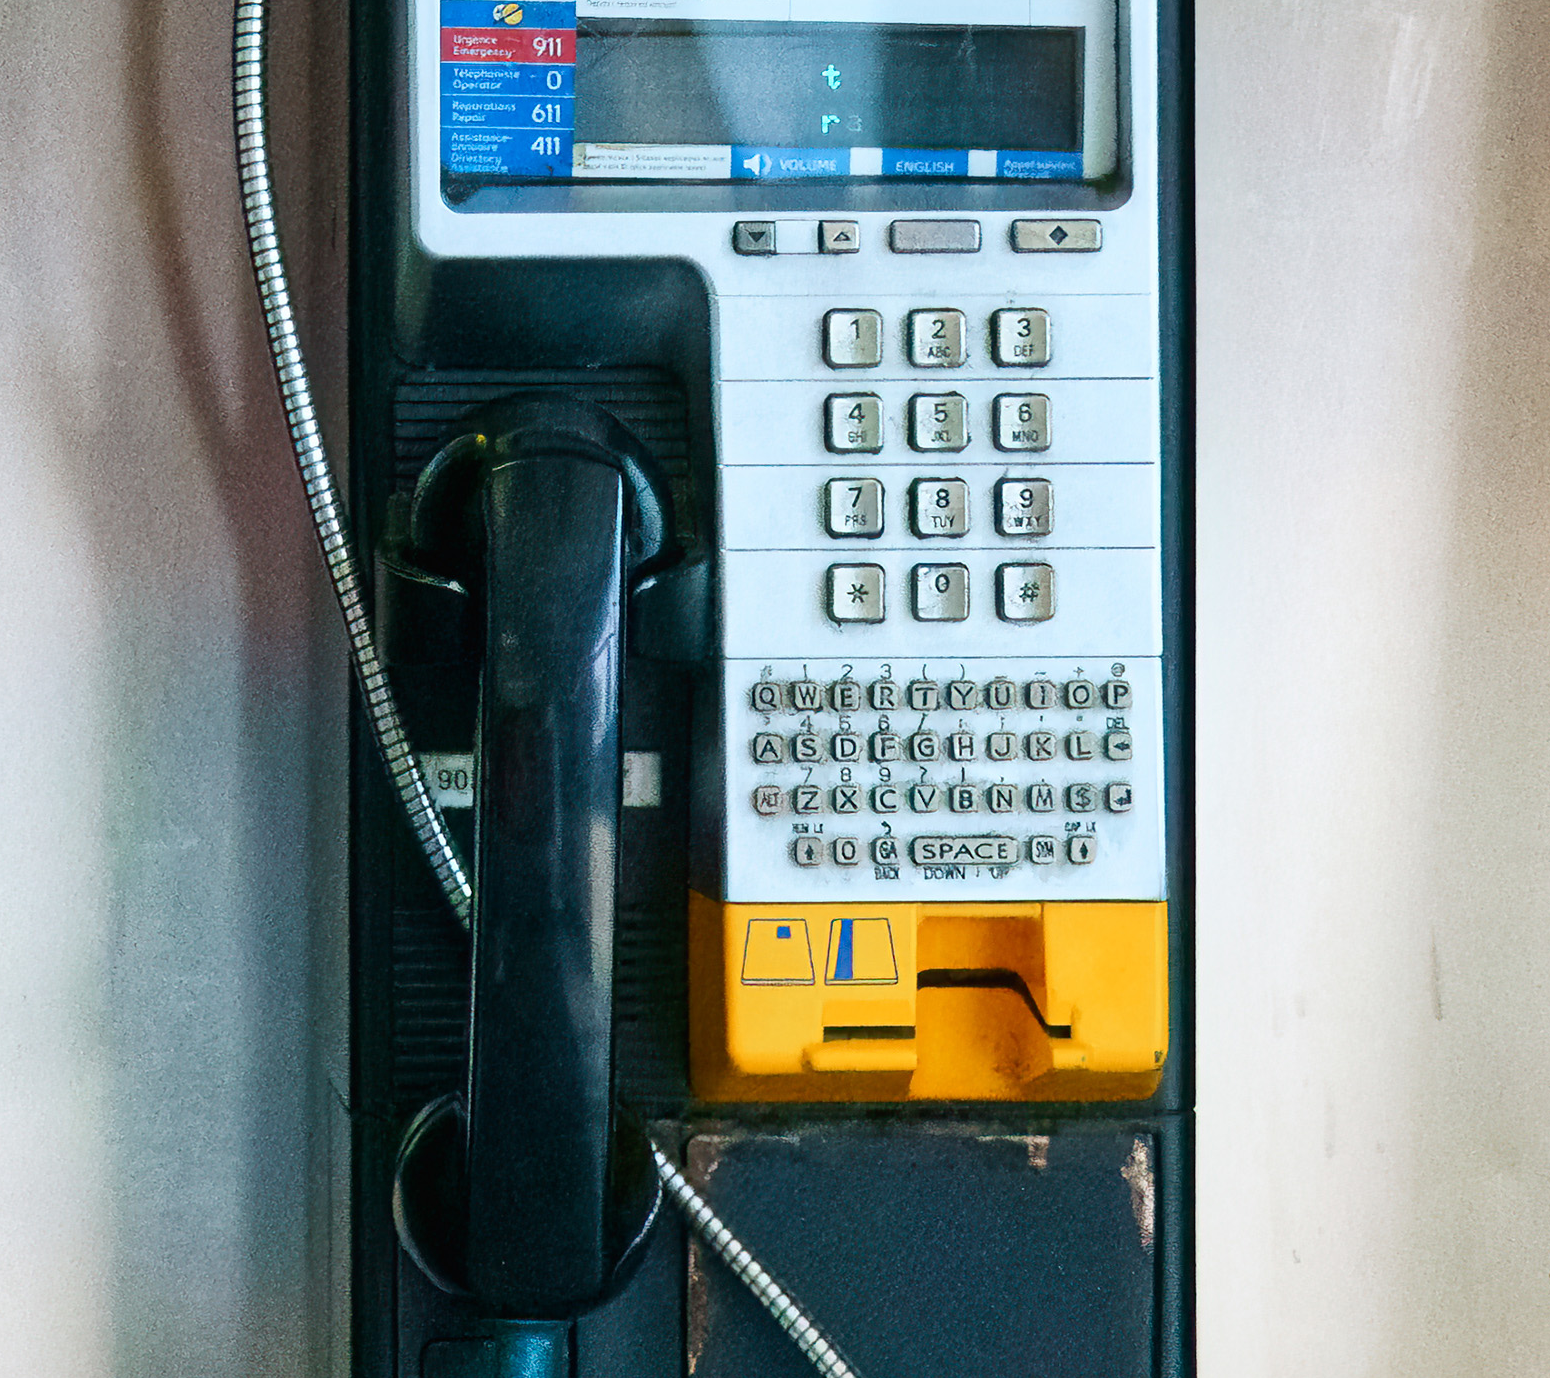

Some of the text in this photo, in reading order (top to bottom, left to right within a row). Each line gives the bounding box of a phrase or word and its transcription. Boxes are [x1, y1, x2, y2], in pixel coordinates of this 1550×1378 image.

[453, 35, 562, 57] Urgence 911
[453, 47, 513, 58] Emergency
[453, 80, 502, 90] Operator
[546, 70, 562, 90] 0
[821, 64, 841, 89] t
[452, 113, 486, 124] Repair
[531, 104, 561, 123] 611
[530, 136, 561, 156] 411
[779, 158, 838, 172] VOLUME
[895, 161, 955, 174] ENGLISH
[849, 319, 861, 340] 1
[932, 319, 946, 340] 2
[1017, 318, 1032, 339] 3
[849, 403, 866, 424] 4
[933, 403, 949, 422] 5
[1018, 403, 1033, 422] 6
[848, 487, 863, 508] 7
[935, 488, 950, 508] 8
[1019, 488, 1034, 508] 9
[934, 573, 950, 594] 0
[759, 684, 1129, 708] Q W E R T Y U P
[759, 736, 1092, 759] A S D F G H J K L
[437, 768, 469, 791] 90
[922, 843, 1008, 861] SPACE
